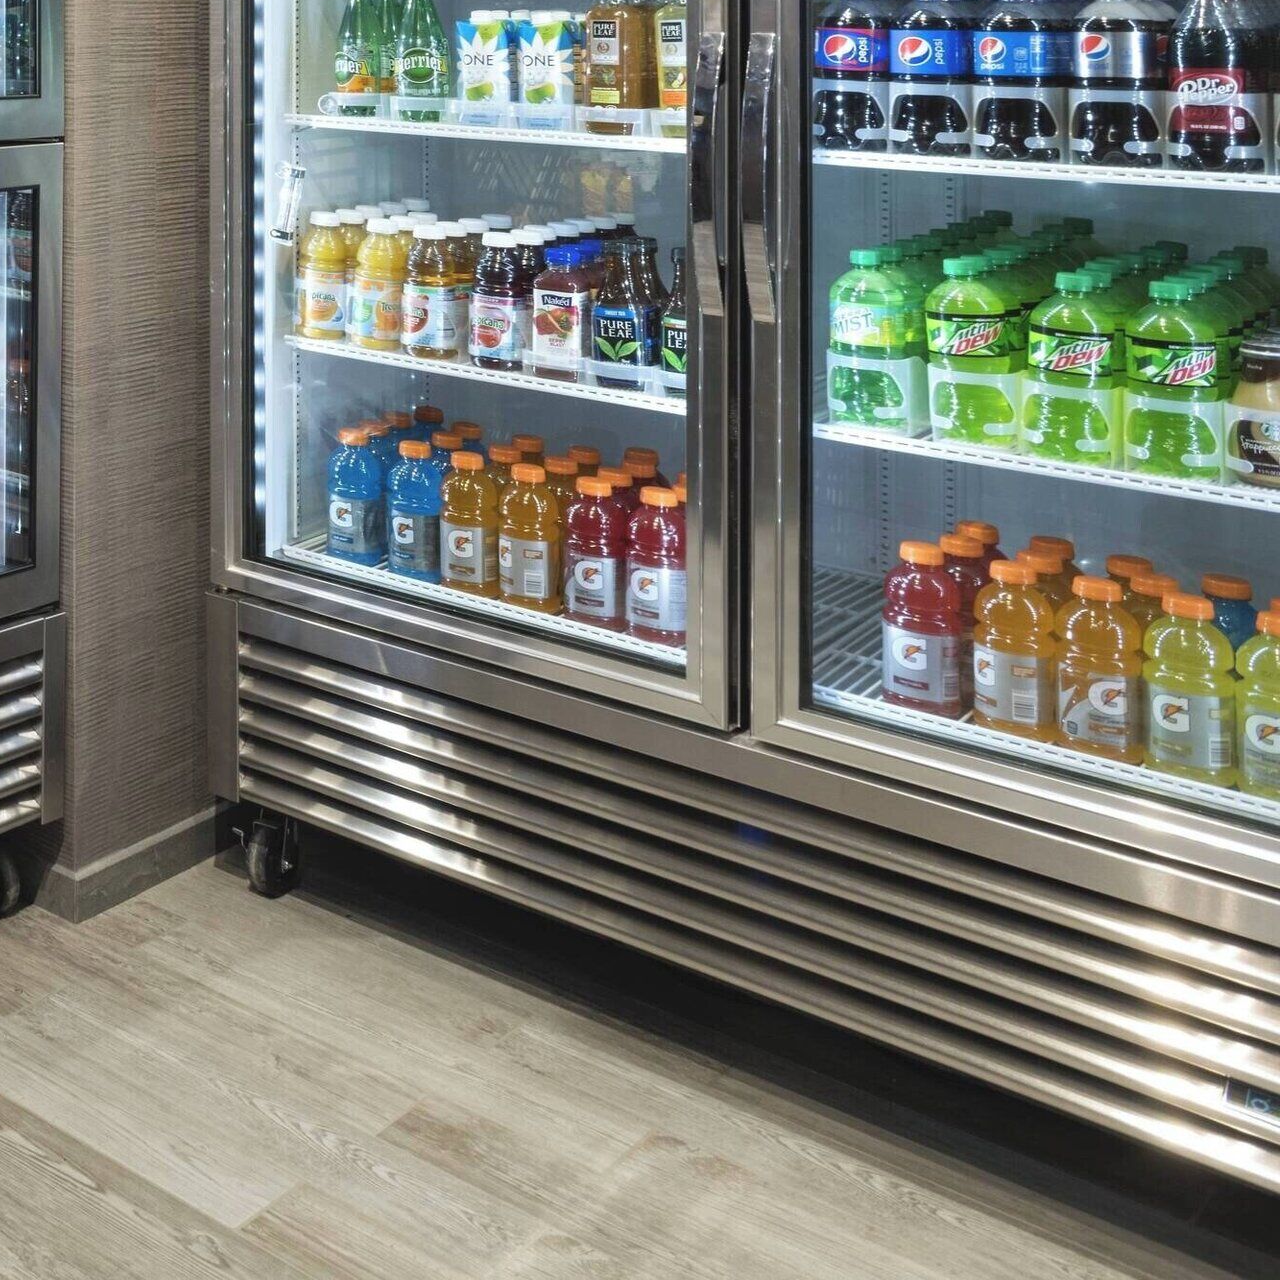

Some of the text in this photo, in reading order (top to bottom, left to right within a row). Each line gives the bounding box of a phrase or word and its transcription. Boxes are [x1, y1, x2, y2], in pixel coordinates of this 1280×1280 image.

[857, 36, 869, 63] pepsi
[934, 38, 946, 65] pepsi
[463, 53, 494, 66] ONE
[522, 54, 555, 67] ONE
[1198, 77, 1219, 89] Dr
[1180, 80, 1234, 102] Pepper
[600, 320, 632, 330] PURE
